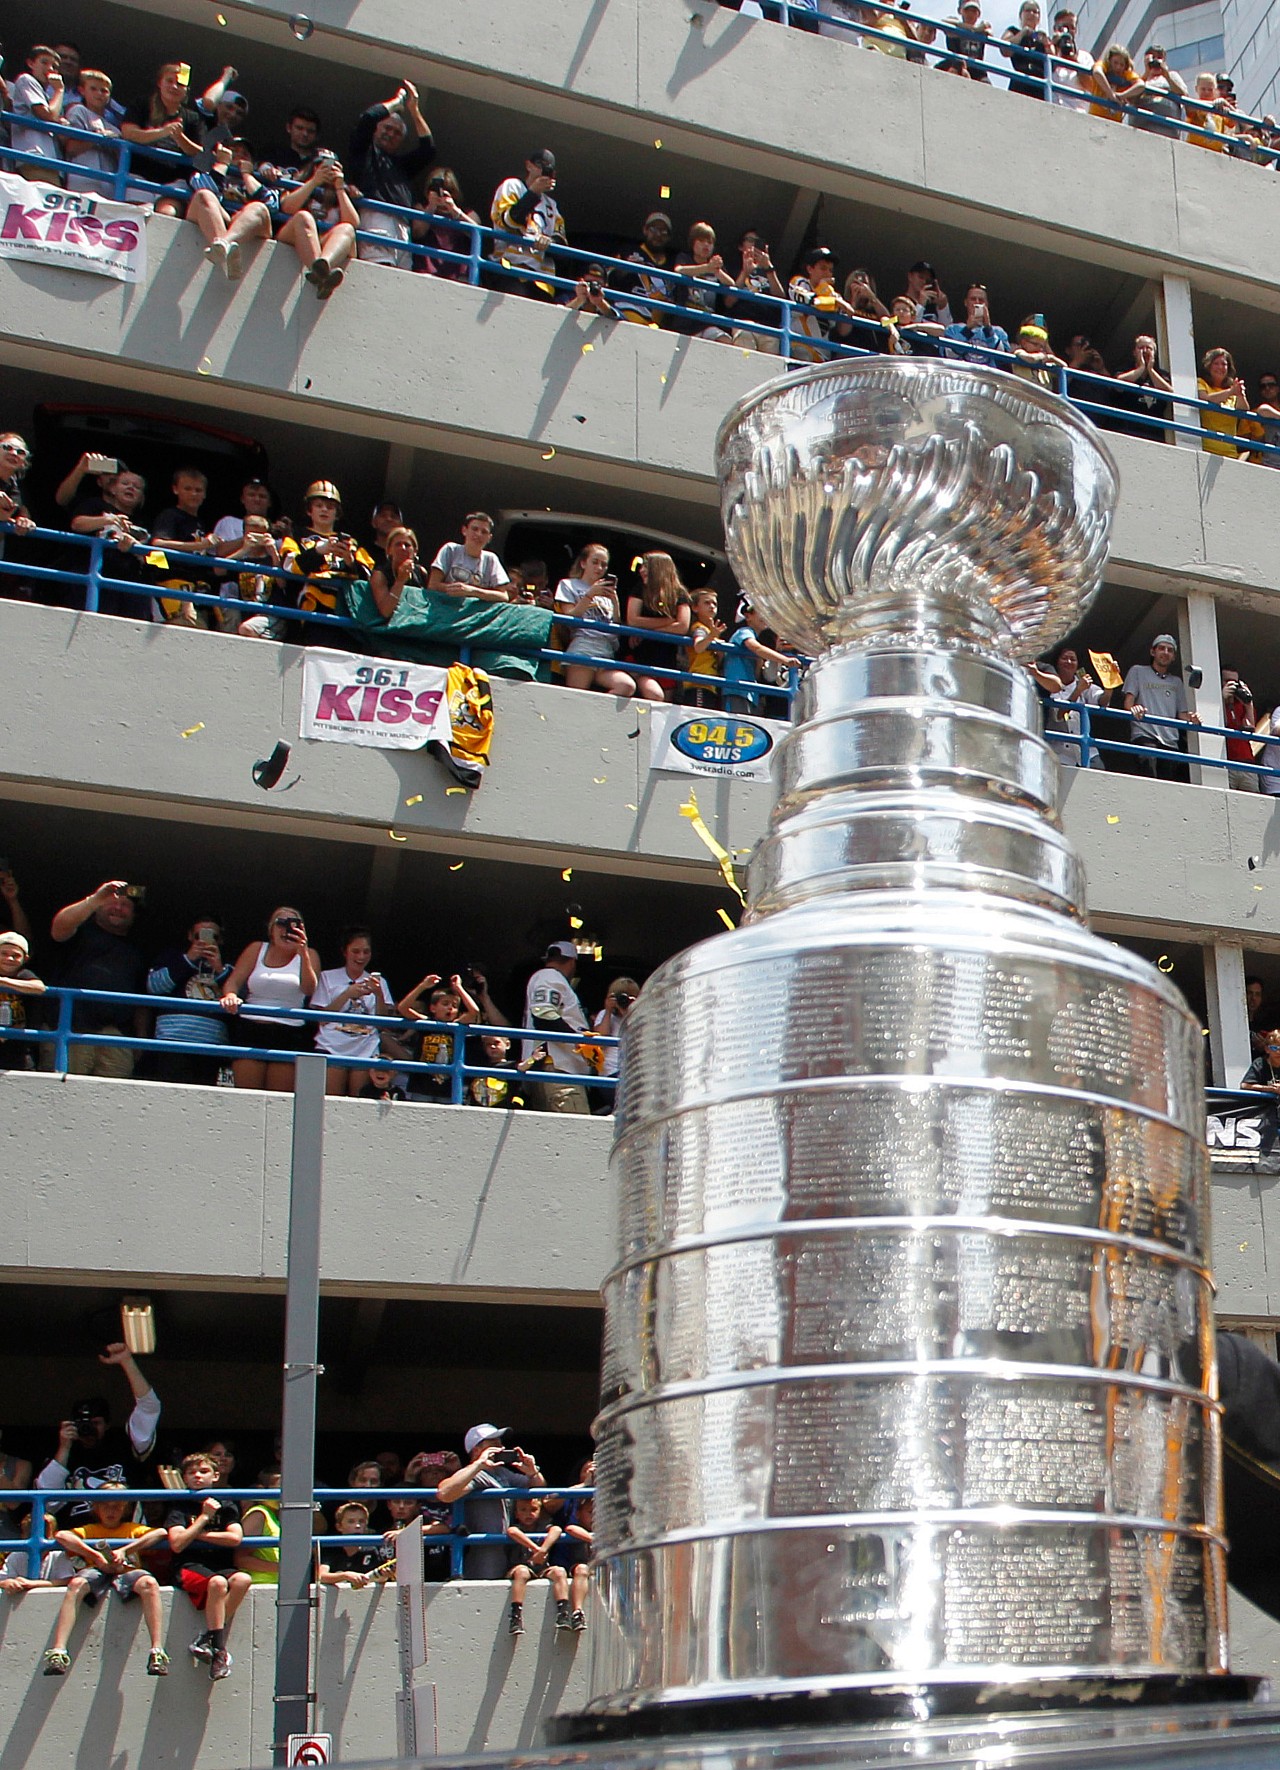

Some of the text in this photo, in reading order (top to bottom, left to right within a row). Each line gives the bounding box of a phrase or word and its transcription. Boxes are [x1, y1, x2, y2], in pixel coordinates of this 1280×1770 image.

[43, 193, 98, 215] 96.1
[1, 203, 139, 252] KISS
[355, 667, 410, 687] 96.1
[315, 683, 444, 725] KISS
[687, 722, 755, 748] 94.5
[702, 745, 742, 761] 3WS
[689, 762, 755, 779] 3wsradio.com
